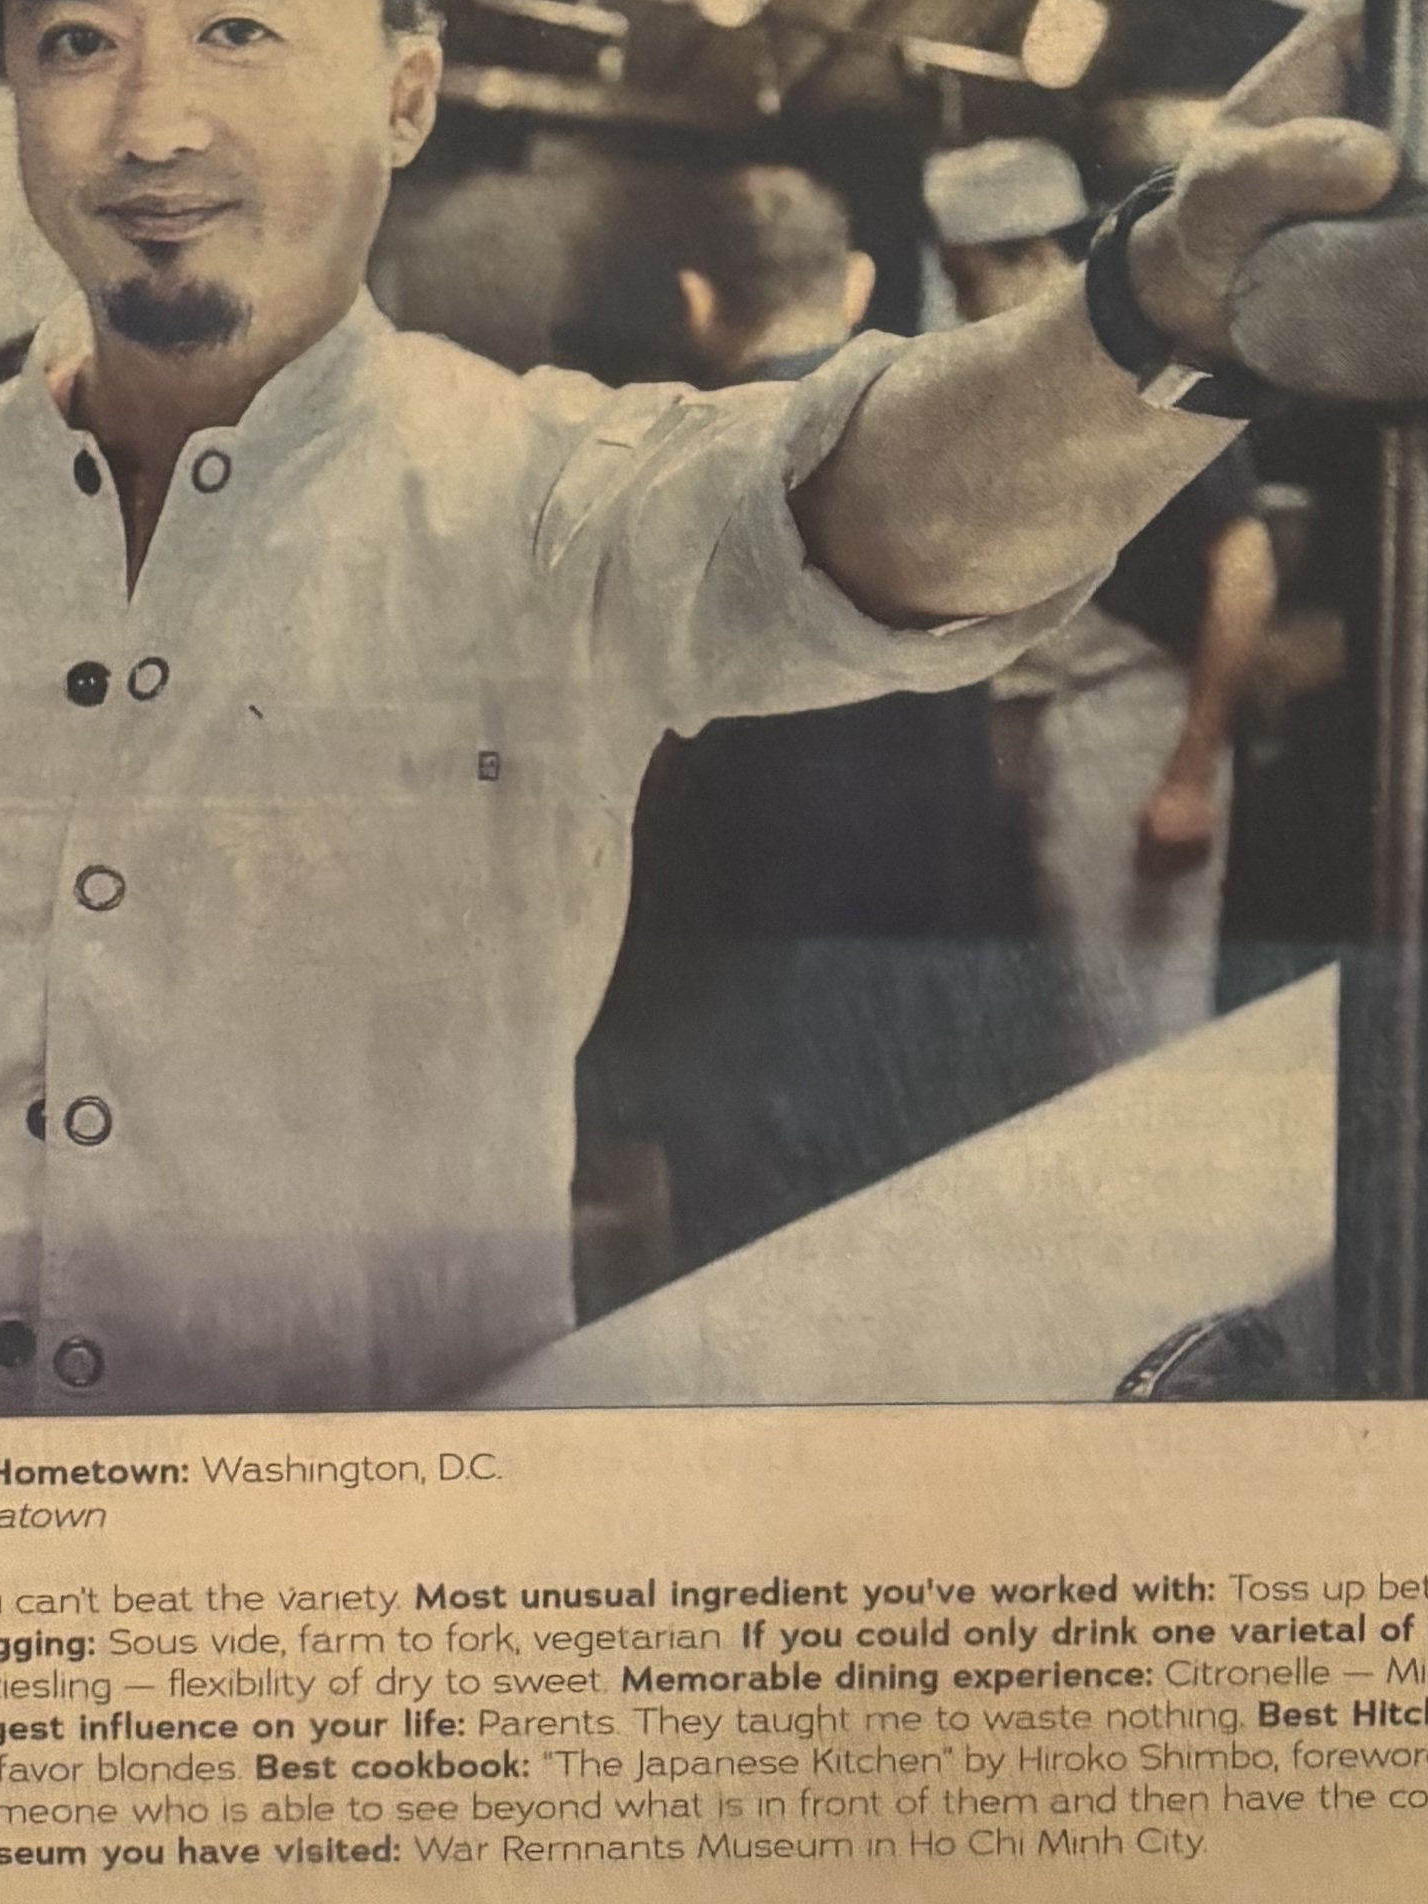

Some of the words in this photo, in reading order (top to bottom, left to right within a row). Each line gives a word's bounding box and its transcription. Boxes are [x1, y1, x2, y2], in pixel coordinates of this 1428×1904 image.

[201, 1453, 427, 1490] Washington,
[438, 1452, 504, 1482] D.C.
[14, 1586, 100, 1615] can't
[113, 1583, 194, 1615] beat
[206, 1582, 266, 1612] the
[414, 1582, 508, 1611] Most
[520, 1577, 656, 1610] unusual
[670, 1575, 849, 1614] ingredient
[862, 1576, 976, 1613] you've
[990, 1572, 1118, 1605] worked
[1132, 1571, 1216, 1604] with:
[1228, 1573, 1310, 1602] Toss
[1322, 1580, 1366, 1609] up
[101, 1844, 165, 1873] you
[177, 1834, 261, 1866] have
[274, 1832, 401, 1865] visited:
[413, 1835, 490, 1863] War
[696, 1831, 854, 1860] Museum
[866, 1837, 896, 1858] in
[910, 1829, 957, 1857] Ho
[968, 1826, 1024, 1857] Chi
[1037, 1824, 1124, 1857] Minh
